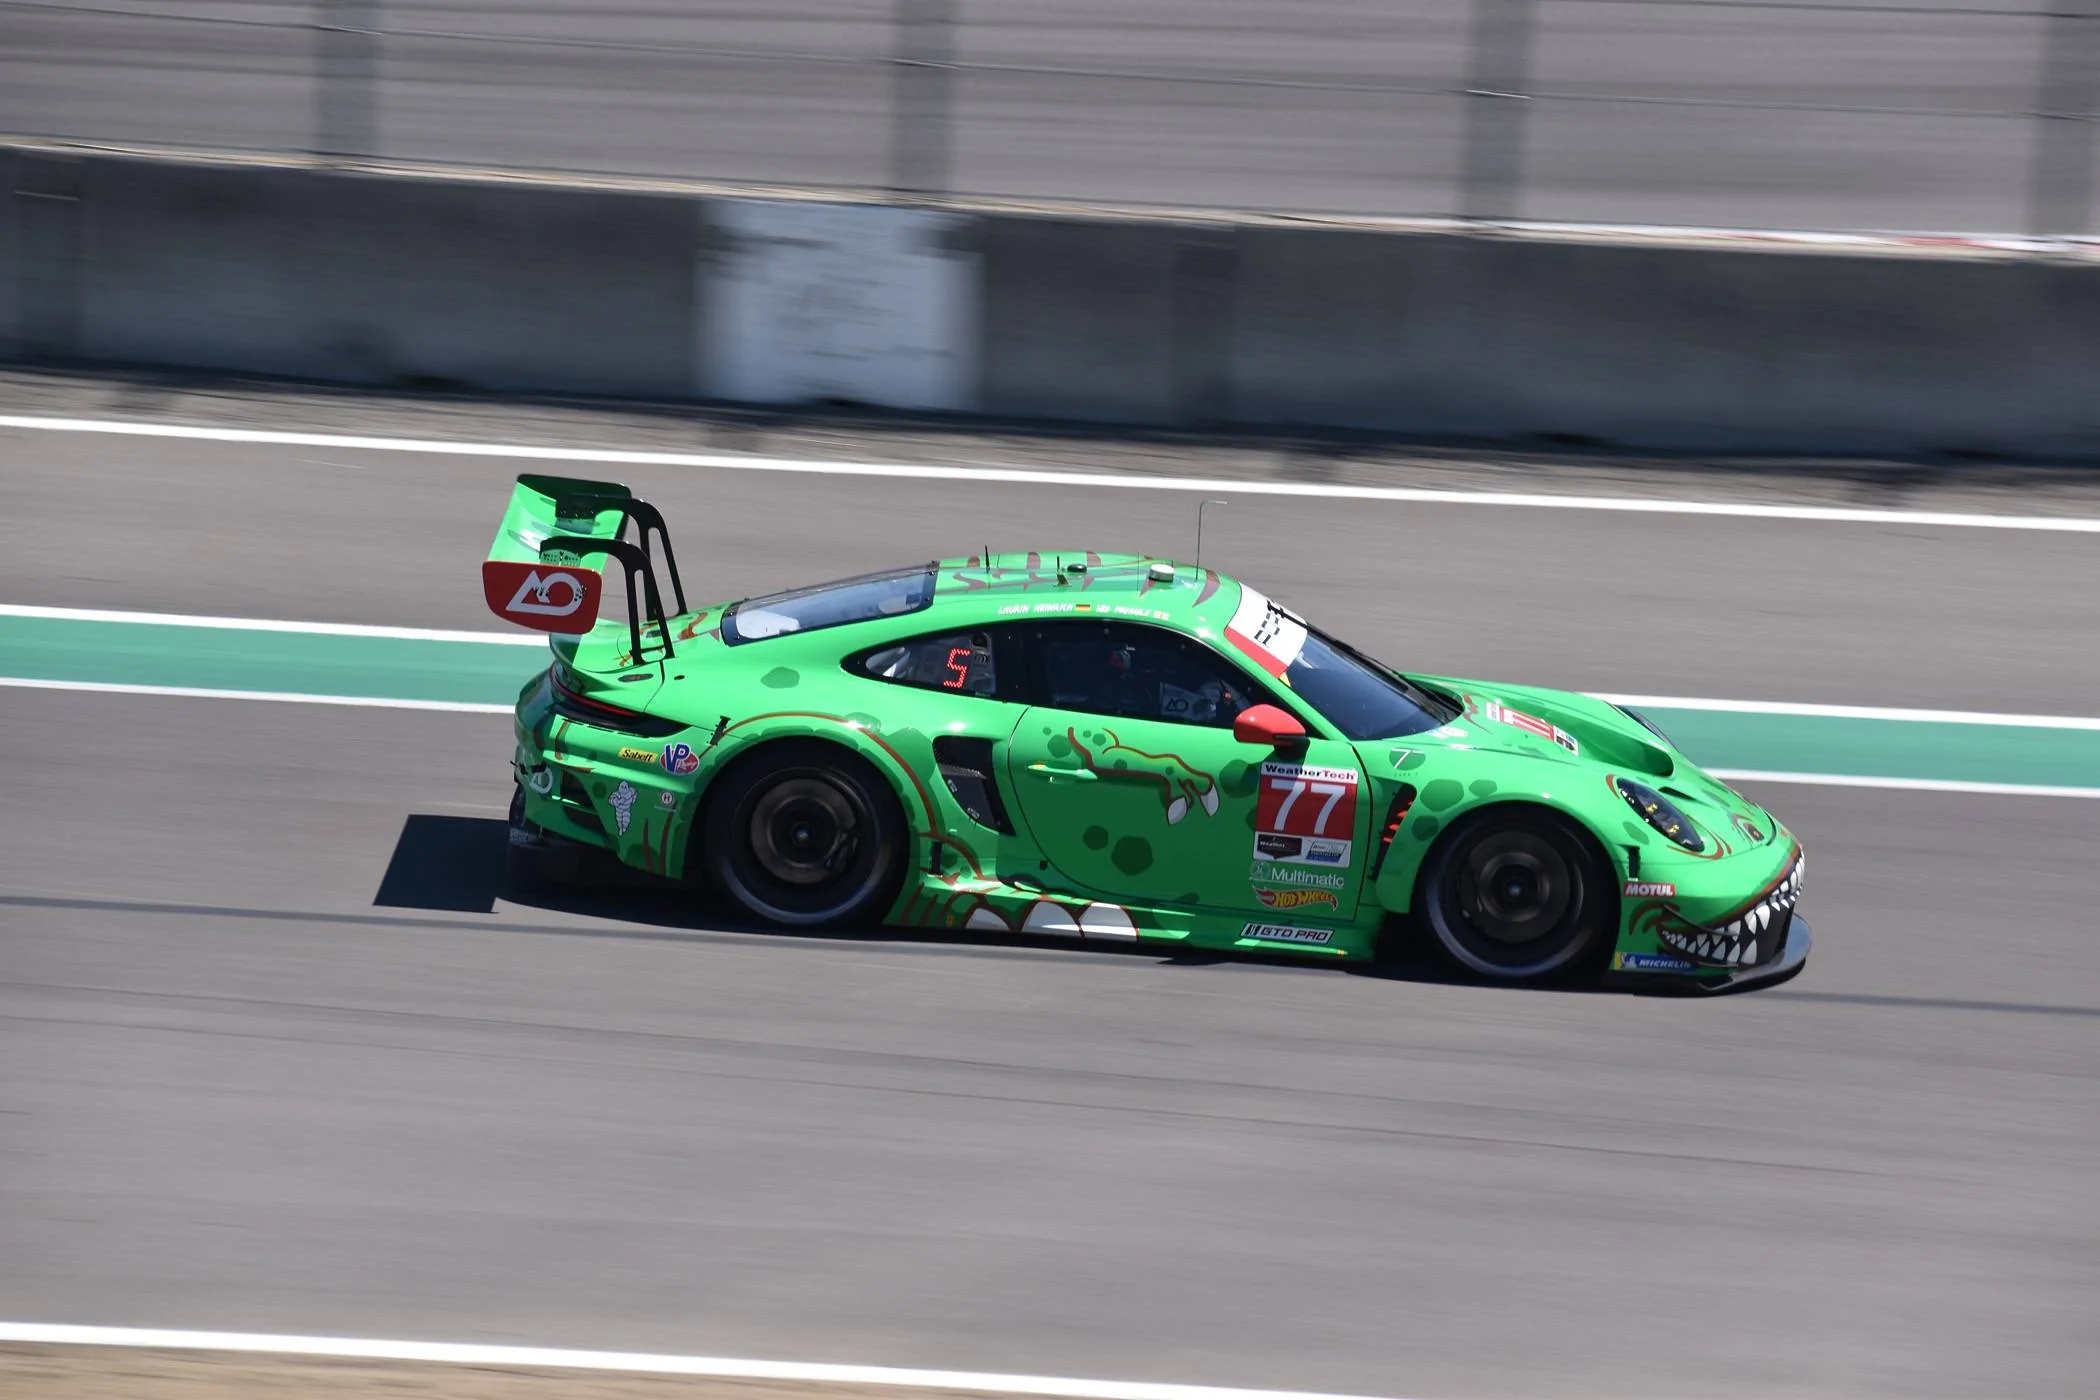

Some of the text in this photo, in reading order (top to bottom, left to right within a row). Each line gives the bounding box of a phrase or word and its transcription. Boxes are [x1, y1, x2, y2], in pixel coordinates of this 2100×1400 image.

[1265, 764, 1354, 780] WeatherTech
[1270, 779, 1346, 835] 77
[1271, 867, 1345, 888] Multimatic
[1625, 883, 1673, 896] MOTUL
[1260, 926, 1329, 941] GTD PRO
[1639, 959, 1692, 969] MICHELIN
